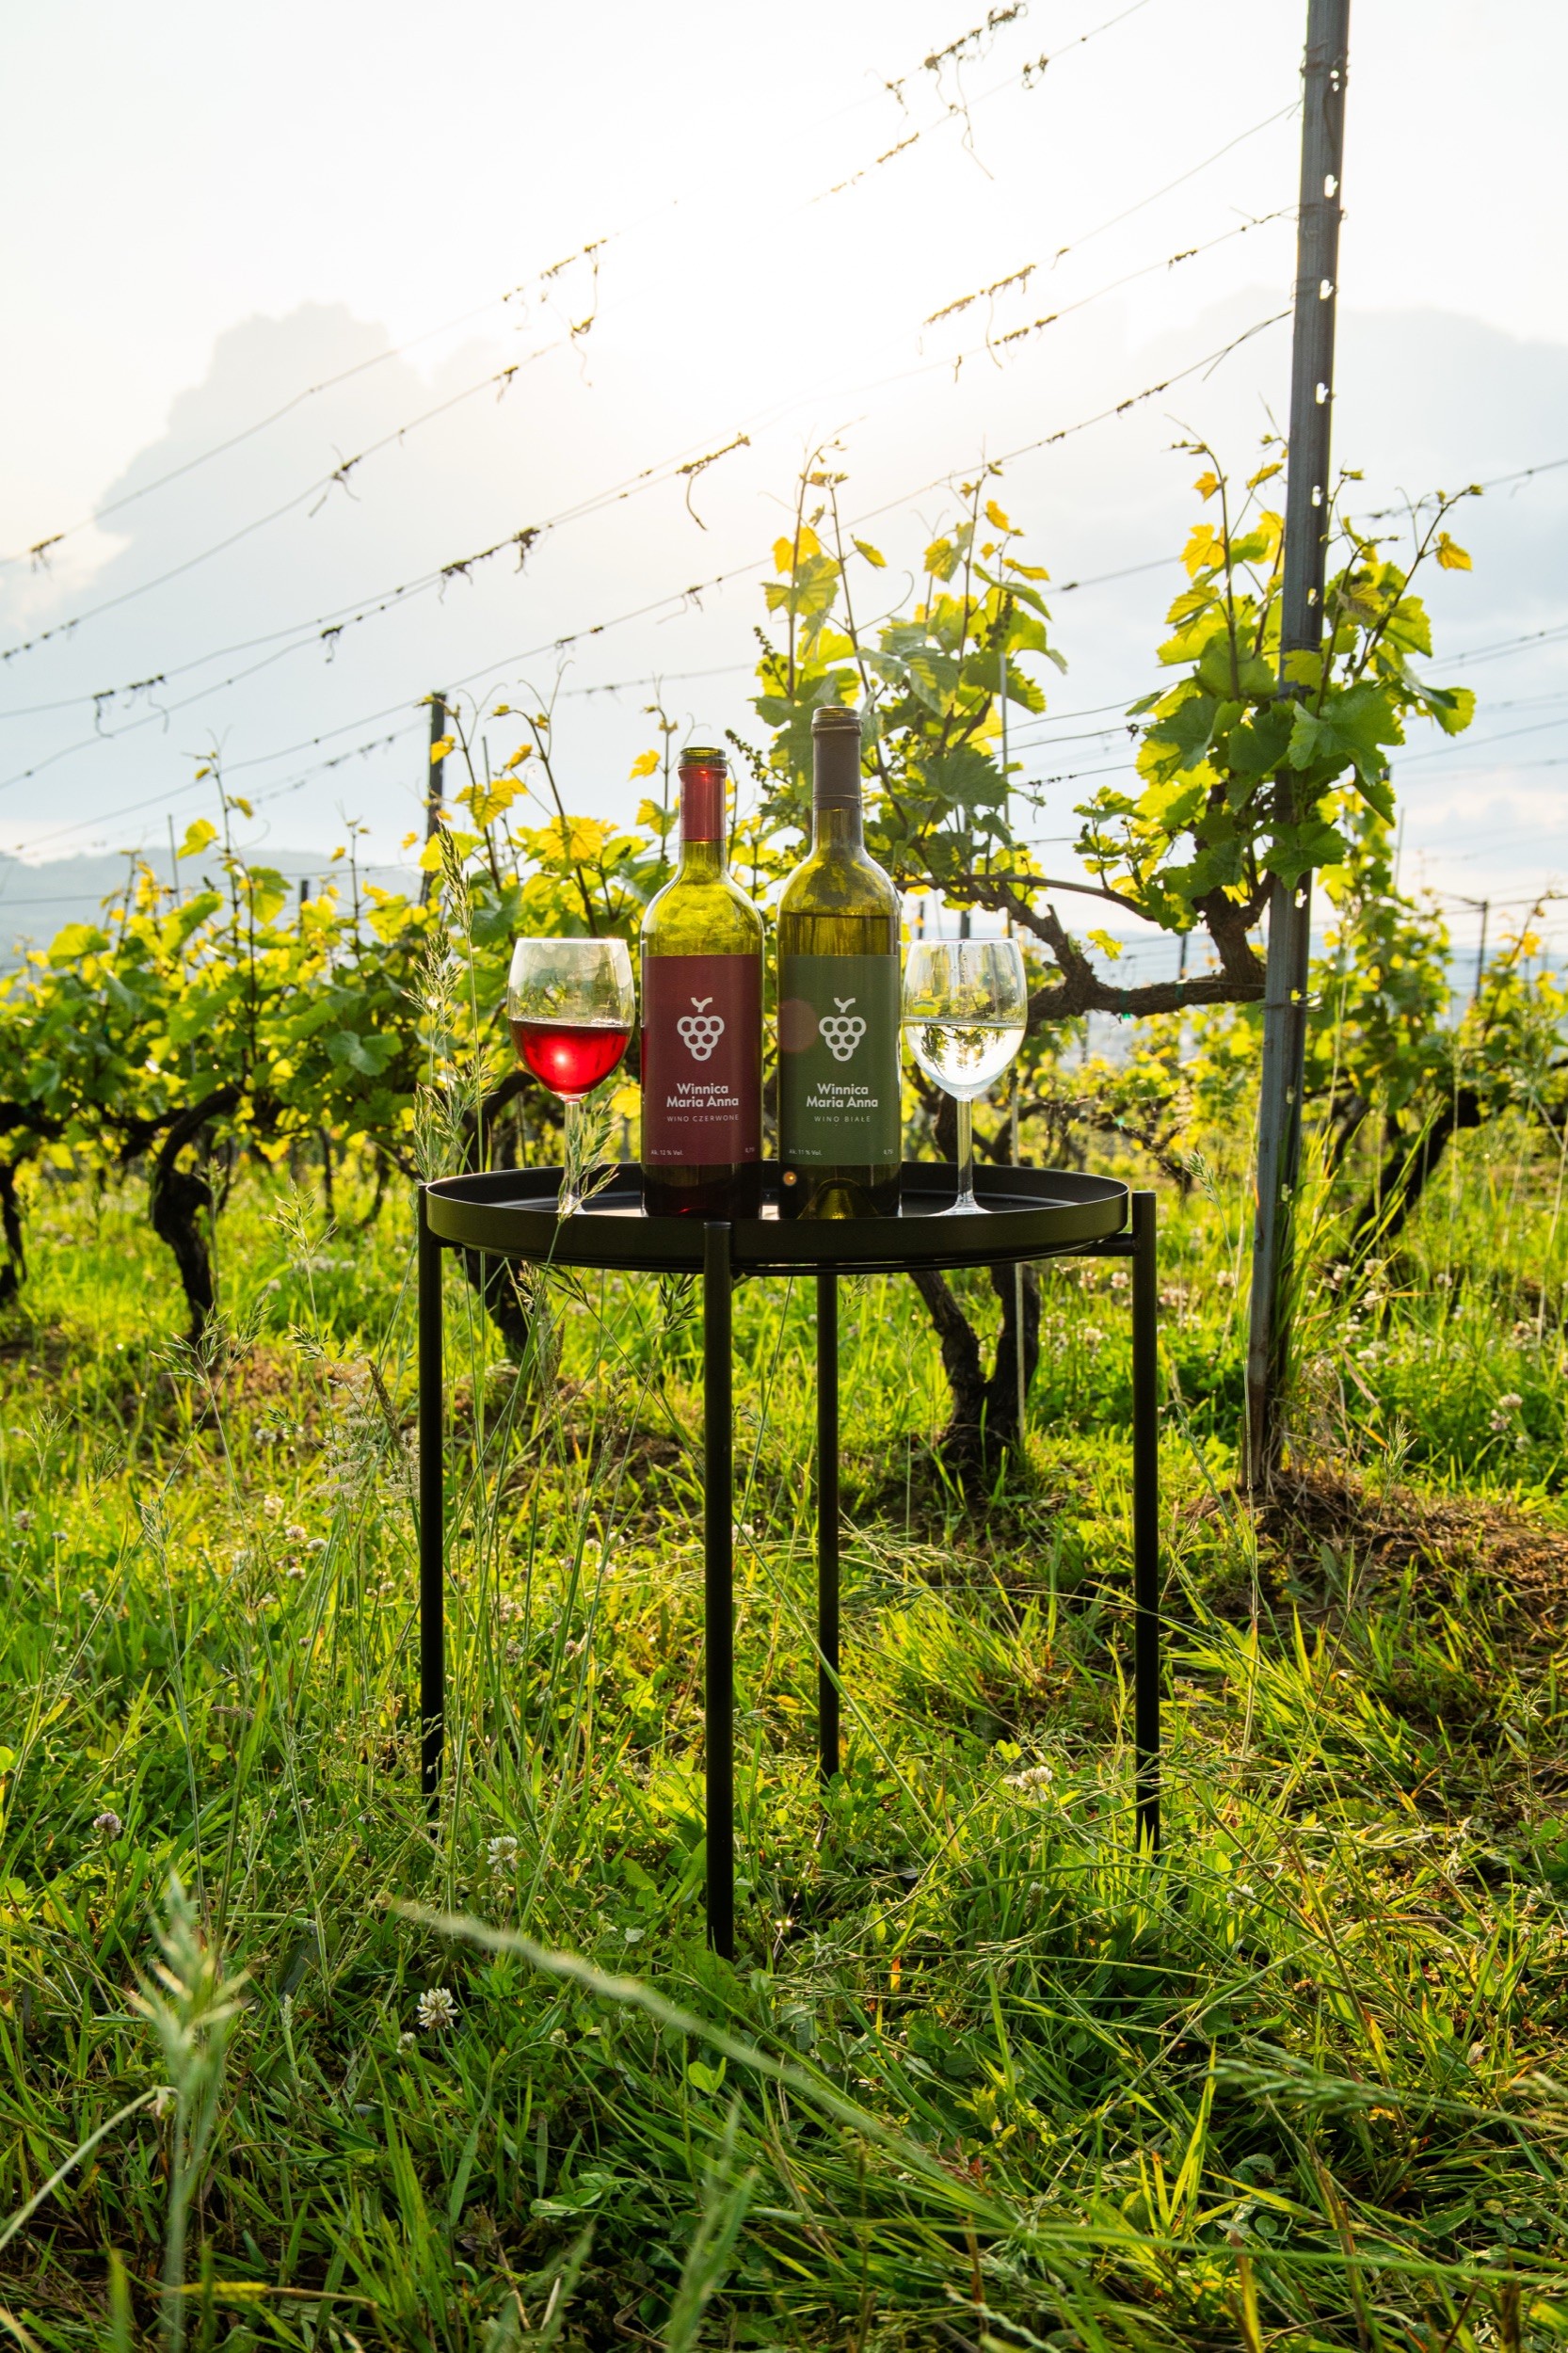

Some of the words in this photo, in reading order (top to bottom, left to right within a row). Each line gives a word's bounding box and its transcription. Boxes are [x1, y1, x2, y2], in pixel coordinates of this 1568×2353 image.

[677, 1083, 728, 1095] Winnica
[817, 1083, 869, 1095] Winnica
[666, 1096, 704, 1108] Maria
[707, 1096, 739, 1107] Anna
[806, 1096, 843, 1108] Maria
[846, 1096, 878, 1108] Anna
